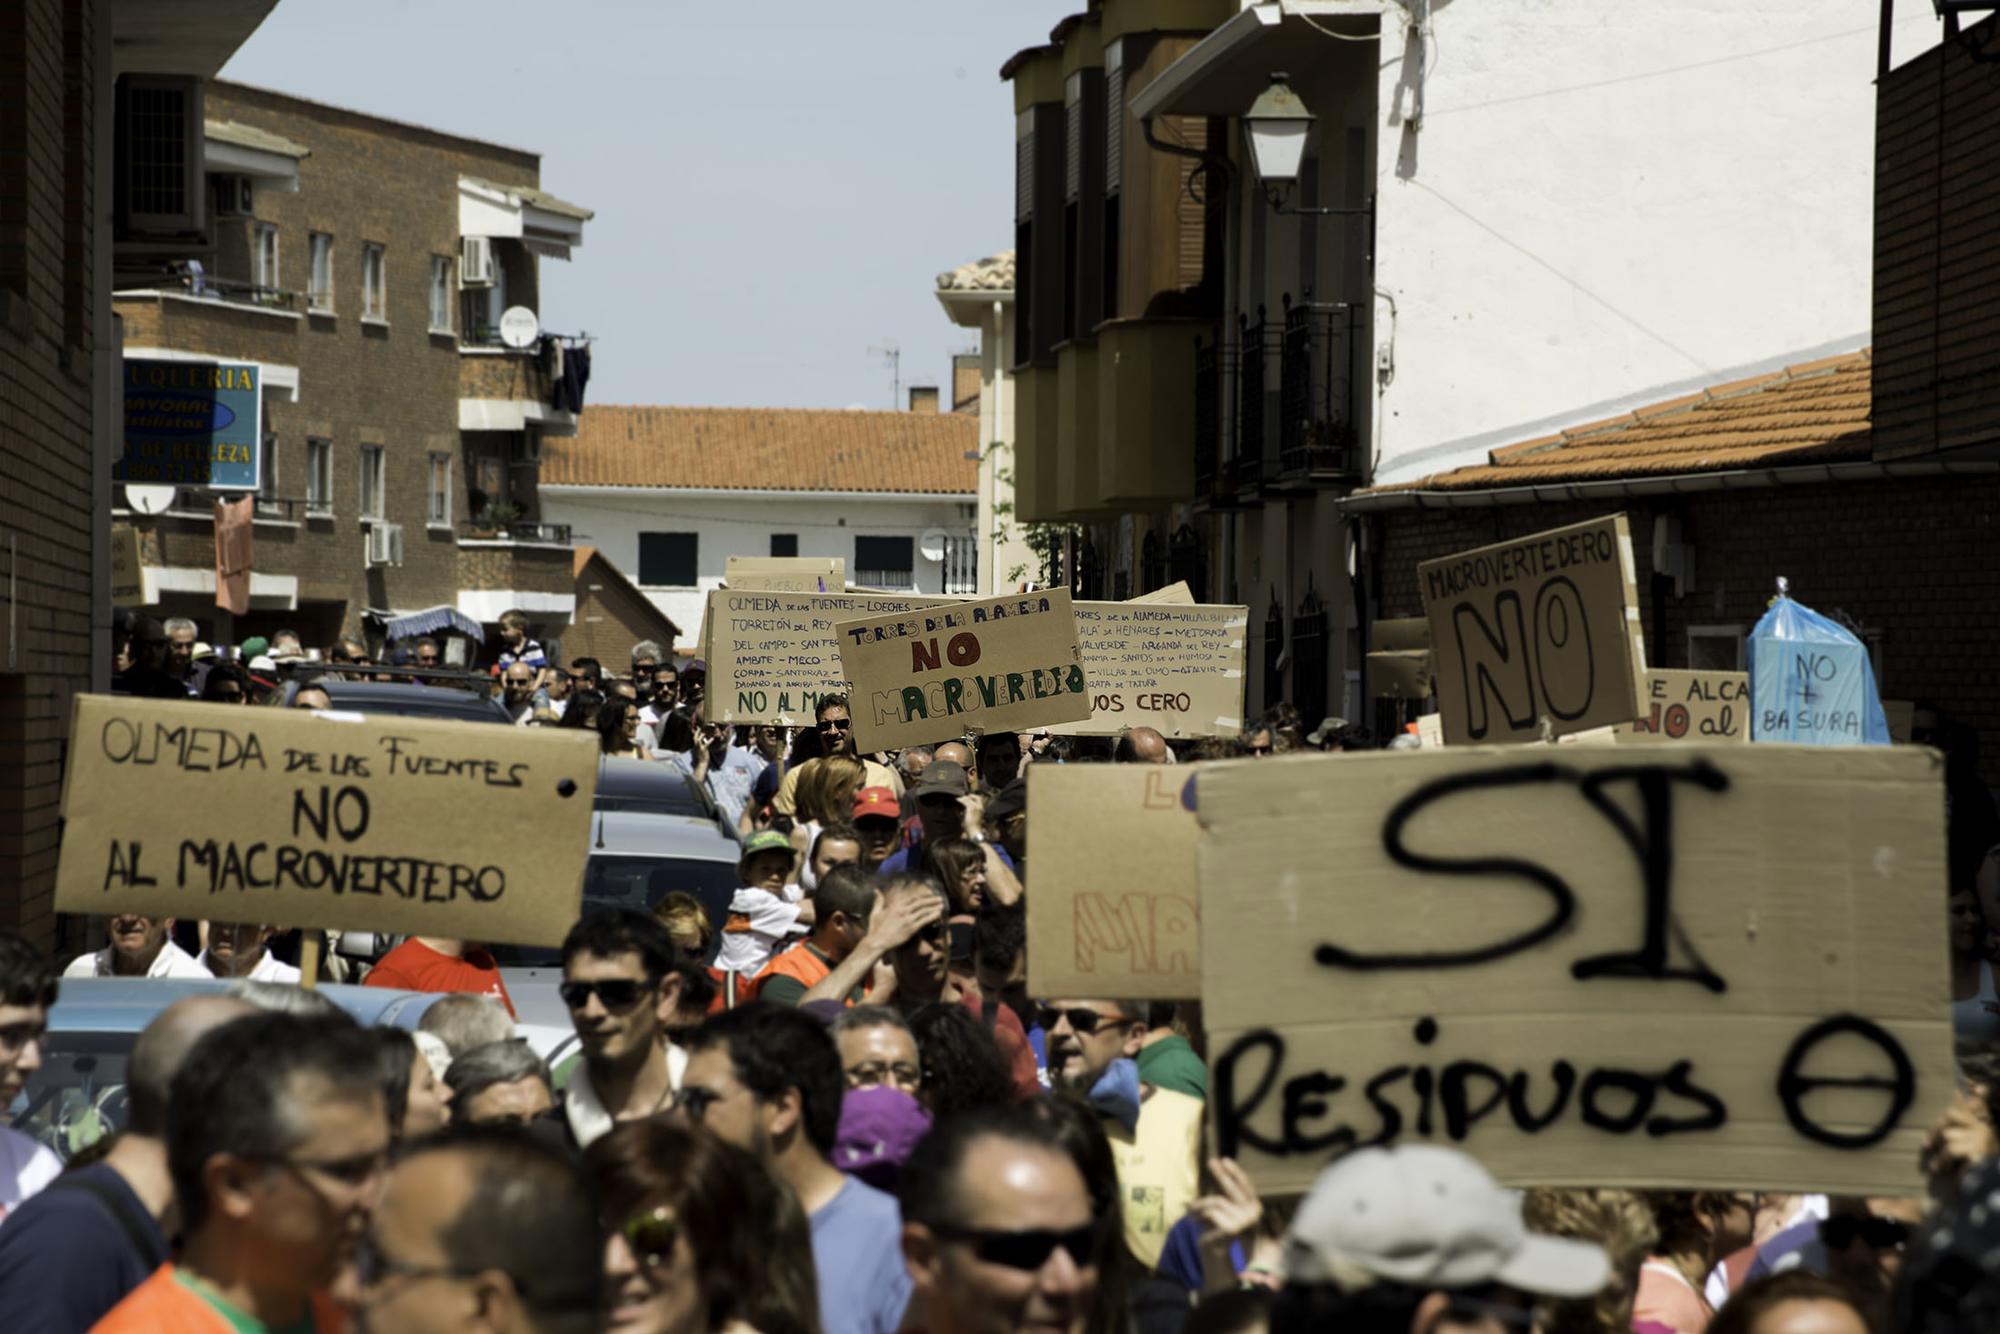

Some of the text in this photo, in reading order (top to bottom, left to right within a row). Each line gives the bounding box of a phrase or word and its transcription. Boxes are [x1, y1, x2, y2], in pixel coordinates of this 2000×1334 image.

[1428, 528, 1614, 600] MACROVERTEDERO
[728, 597, 781, 612] OLMEDA
[811, 599, 855, 612] FUENTES
[867, 601, 911, 612] LOECHES
[1133, 611, 1171, 621] ALAMEDA
[794, 624, 808, 632] DEL
[812, 619, 833, 632] REY
[848, 620, 920, 645] TORRES
[972, 597, 1050, 624] ALAMEDA
[1116, 625, 1160, 638] HENARES
[733, 639, 754, 651] DEL
[800, 639, 819, 650] SAN
[911, 632, 981, 673] NO
[1121, 653, 1153, 663] SANTOS
[1141, 640, 1182, 650] ARGANDA
[1201, 640, 1220, 650] REY
[1453, 574, 1595, 740] NO
[736, 655, 774, 666] AMBITE
[788, 655, 820, 665] MECO
[1796, 653, 1836, 682] NO
[738, 691, 767, 714] NO
[777, 692, 796, 713] AL
[872, 664, 1084, 727] MACROVERTEDERO
[1136, 692, 1190, 712] CERO
[1699, 705, 1739, 737] al
[102, 717, 530, 788] OLMEDA DE LAS FUENTES
[293, 784, 370, 843] NO
[104, 839, 506, 902] AL MACROVERTERO
[1312, 759, 1731, 993] SI
